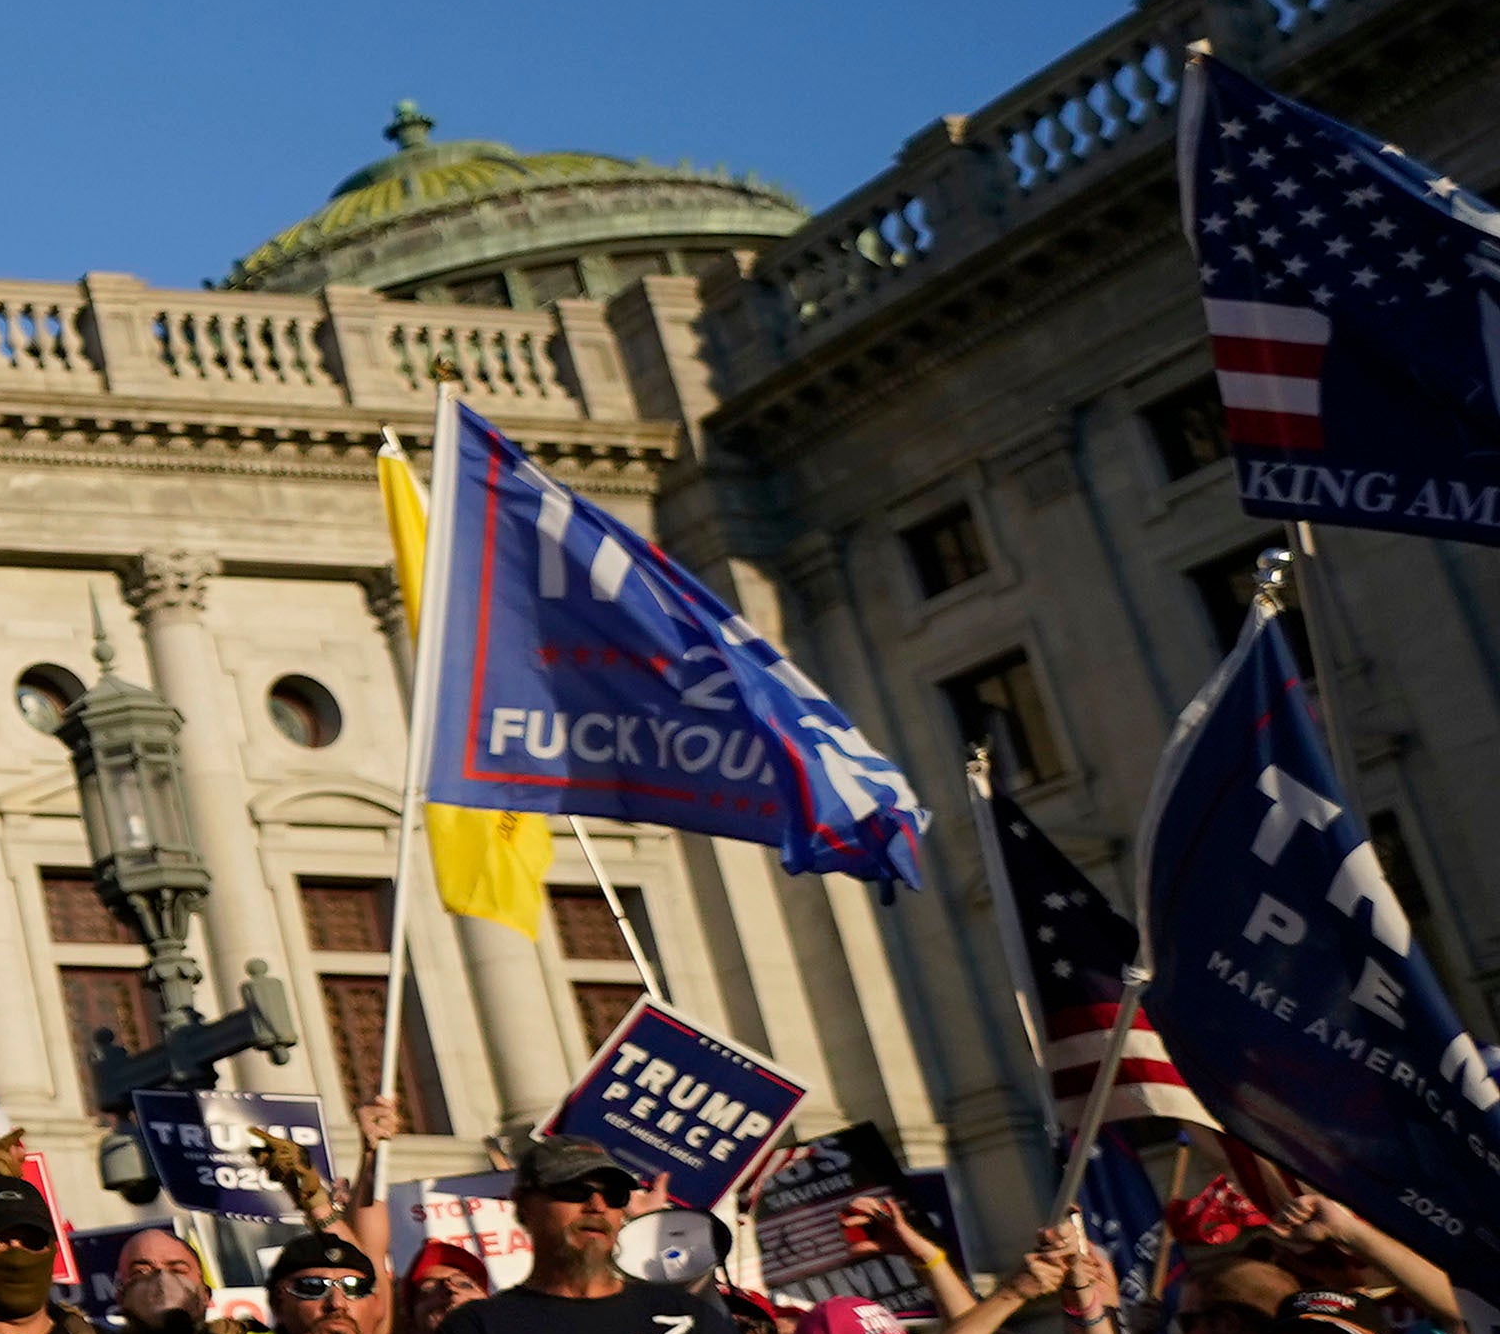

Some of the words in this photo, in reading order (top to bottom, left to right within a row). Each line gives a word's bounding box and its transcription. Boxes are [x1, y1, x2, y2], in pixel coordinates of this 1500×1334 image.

[489, 707, 643, 764] FUCK
[1206, 950, 1299, 1022] MAKE
[1303, 1017, 1459, 1130] AMERICA
[601, 1080, 739, 1163] PENCE
[611, 1041, 774, 1142] TRUMP
[1399, 1187, 1463, 1236] 2020
